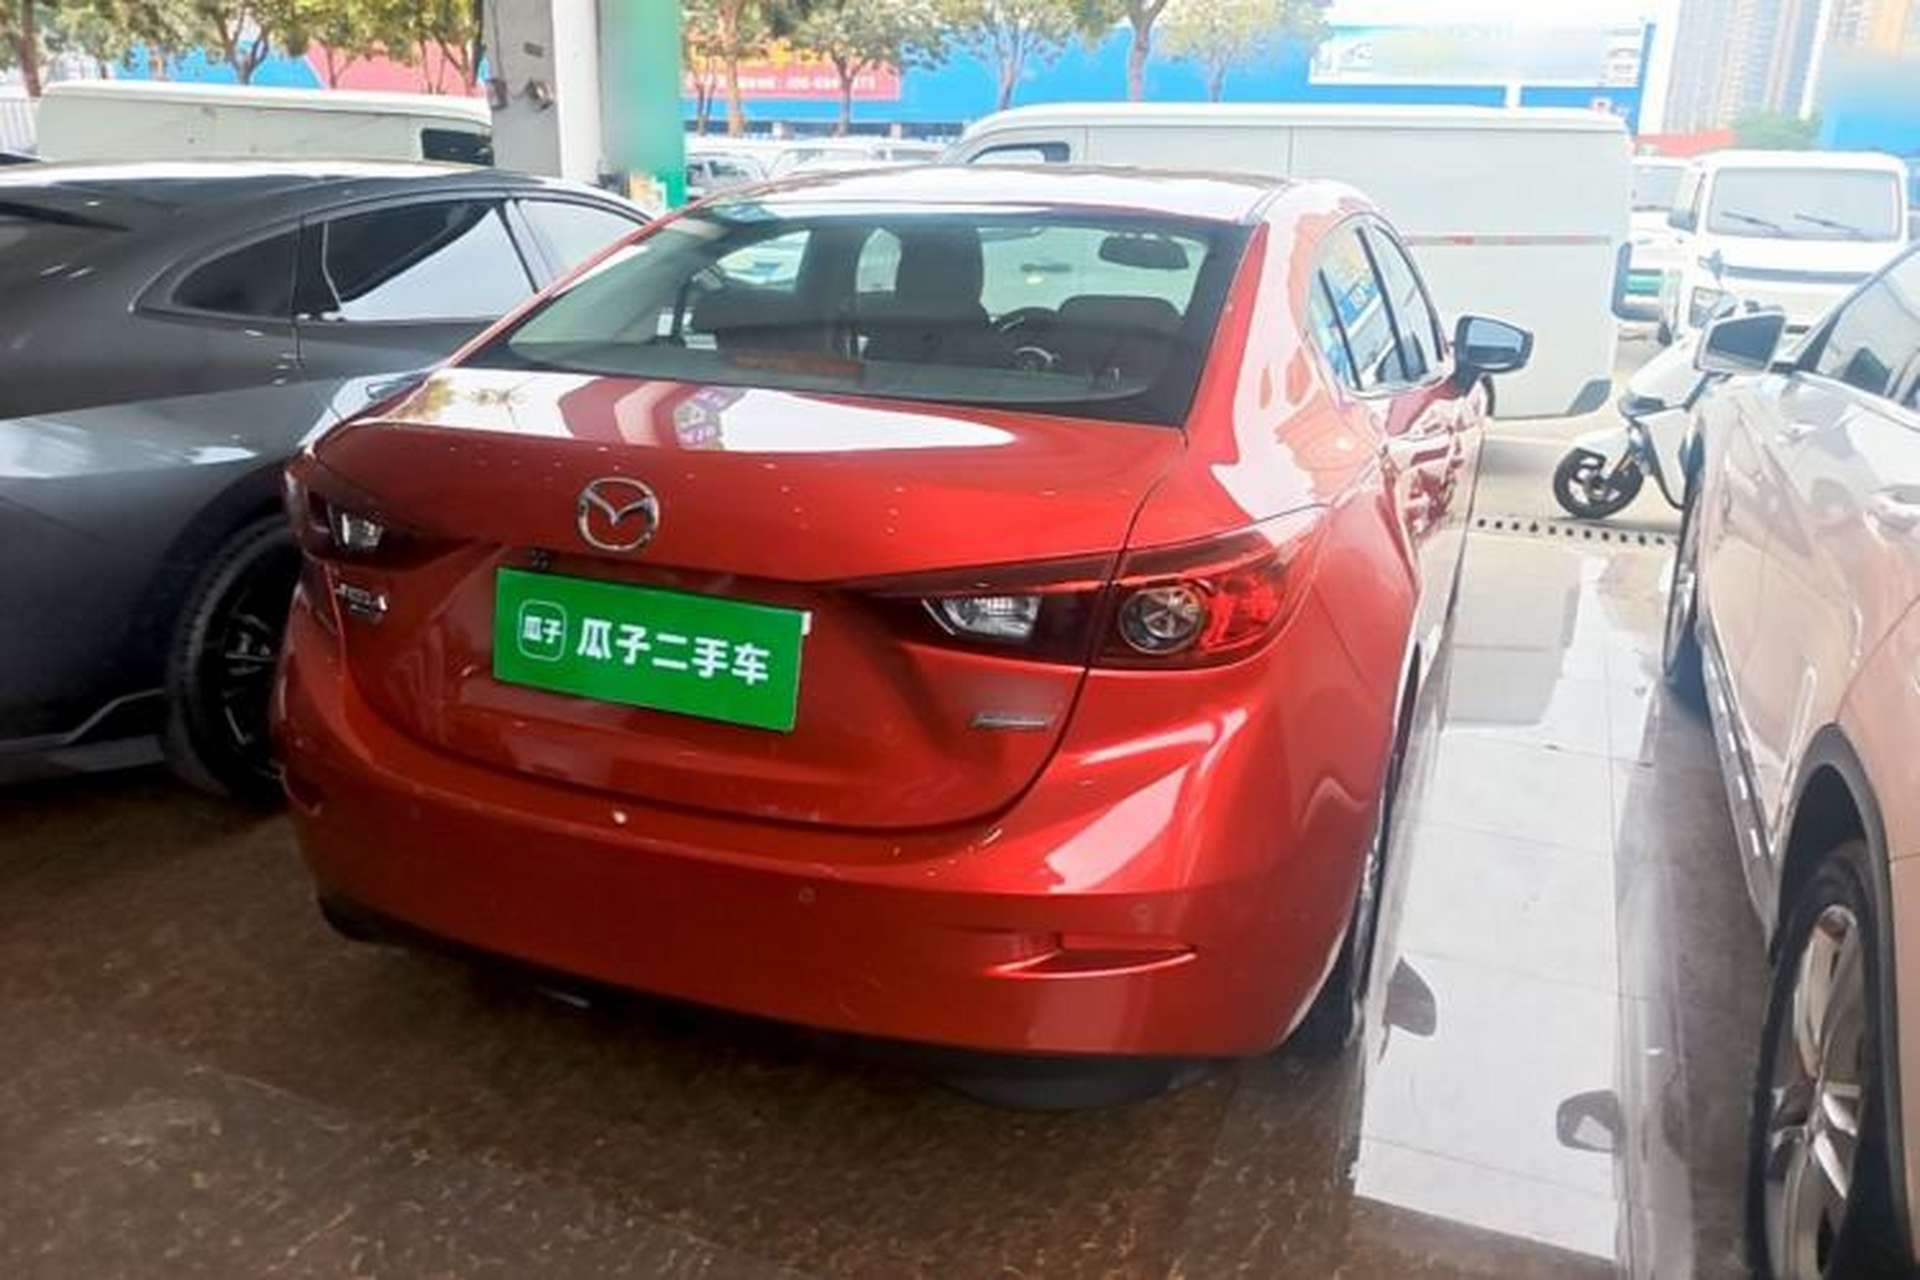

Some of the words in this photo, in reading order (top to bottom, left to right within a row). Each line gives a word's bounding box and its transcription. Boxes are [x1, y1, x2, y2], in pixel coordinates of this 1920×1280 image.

[522, 615, 563, 645] 瓜子
[576, 618, 771, 686] 瓜子二手车
